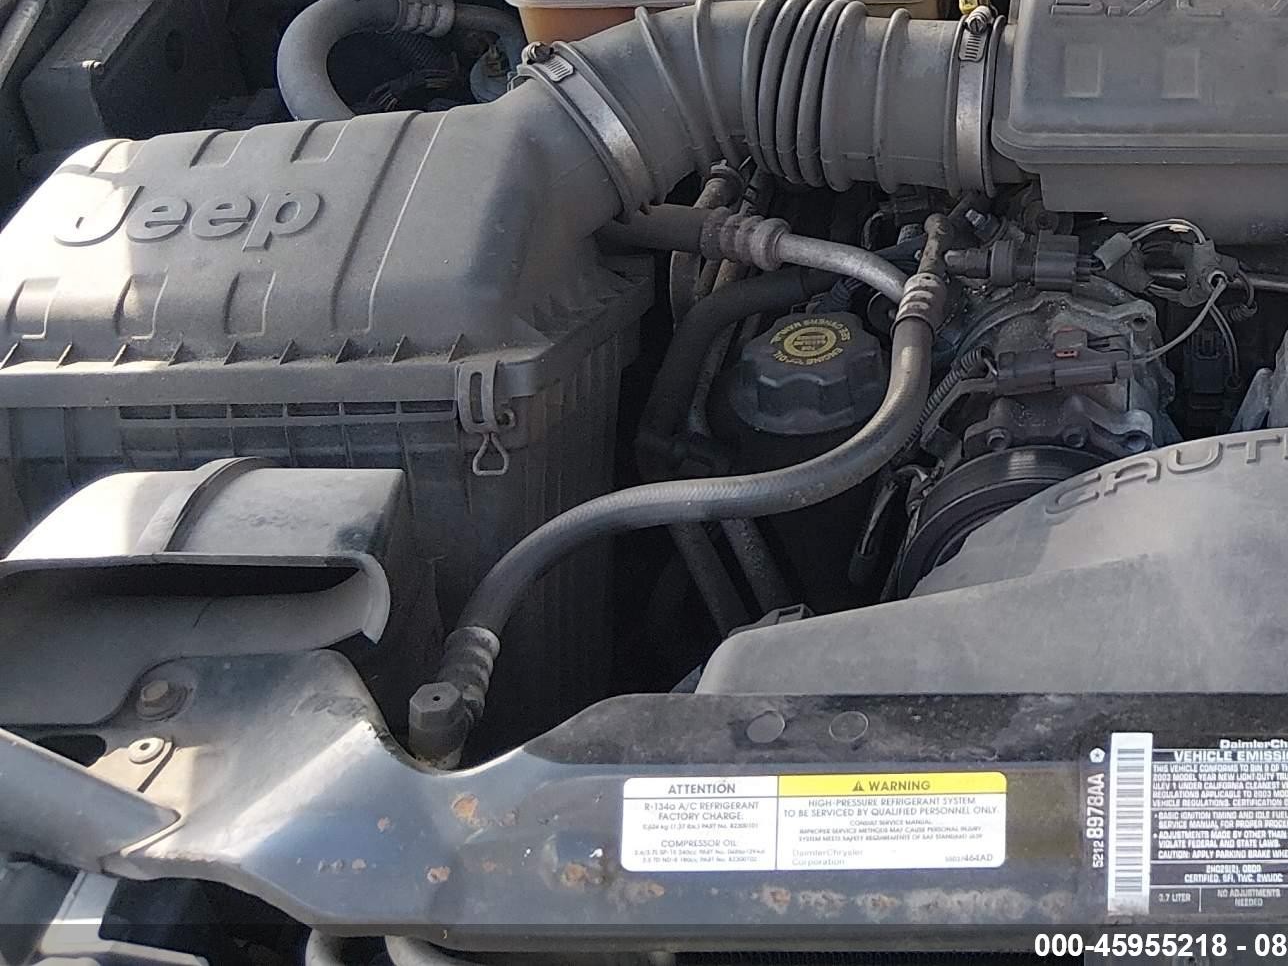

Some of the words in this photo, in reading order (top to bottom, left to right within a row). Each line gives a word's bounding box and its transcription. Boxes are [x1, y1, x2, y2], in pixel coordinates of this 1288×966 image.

[54, 185, 324, 252] Jeep
[1174, 751, 1232, 761] VEHICLE
[668, 784, 735, 794] ATTENTION
[869, 781, 930, 791] WARNING
[678, 802, 696, 810] A/C
[699, 802, 759, 810] REFRIGERANT
[809, 799, 878, 807] HIGH-PRESSURE
[1086, 774, 1104, 838] 8978AA
[919, 807, 970, 815] PERSONNEL
[1093, 840, 1104, 868] 5212
